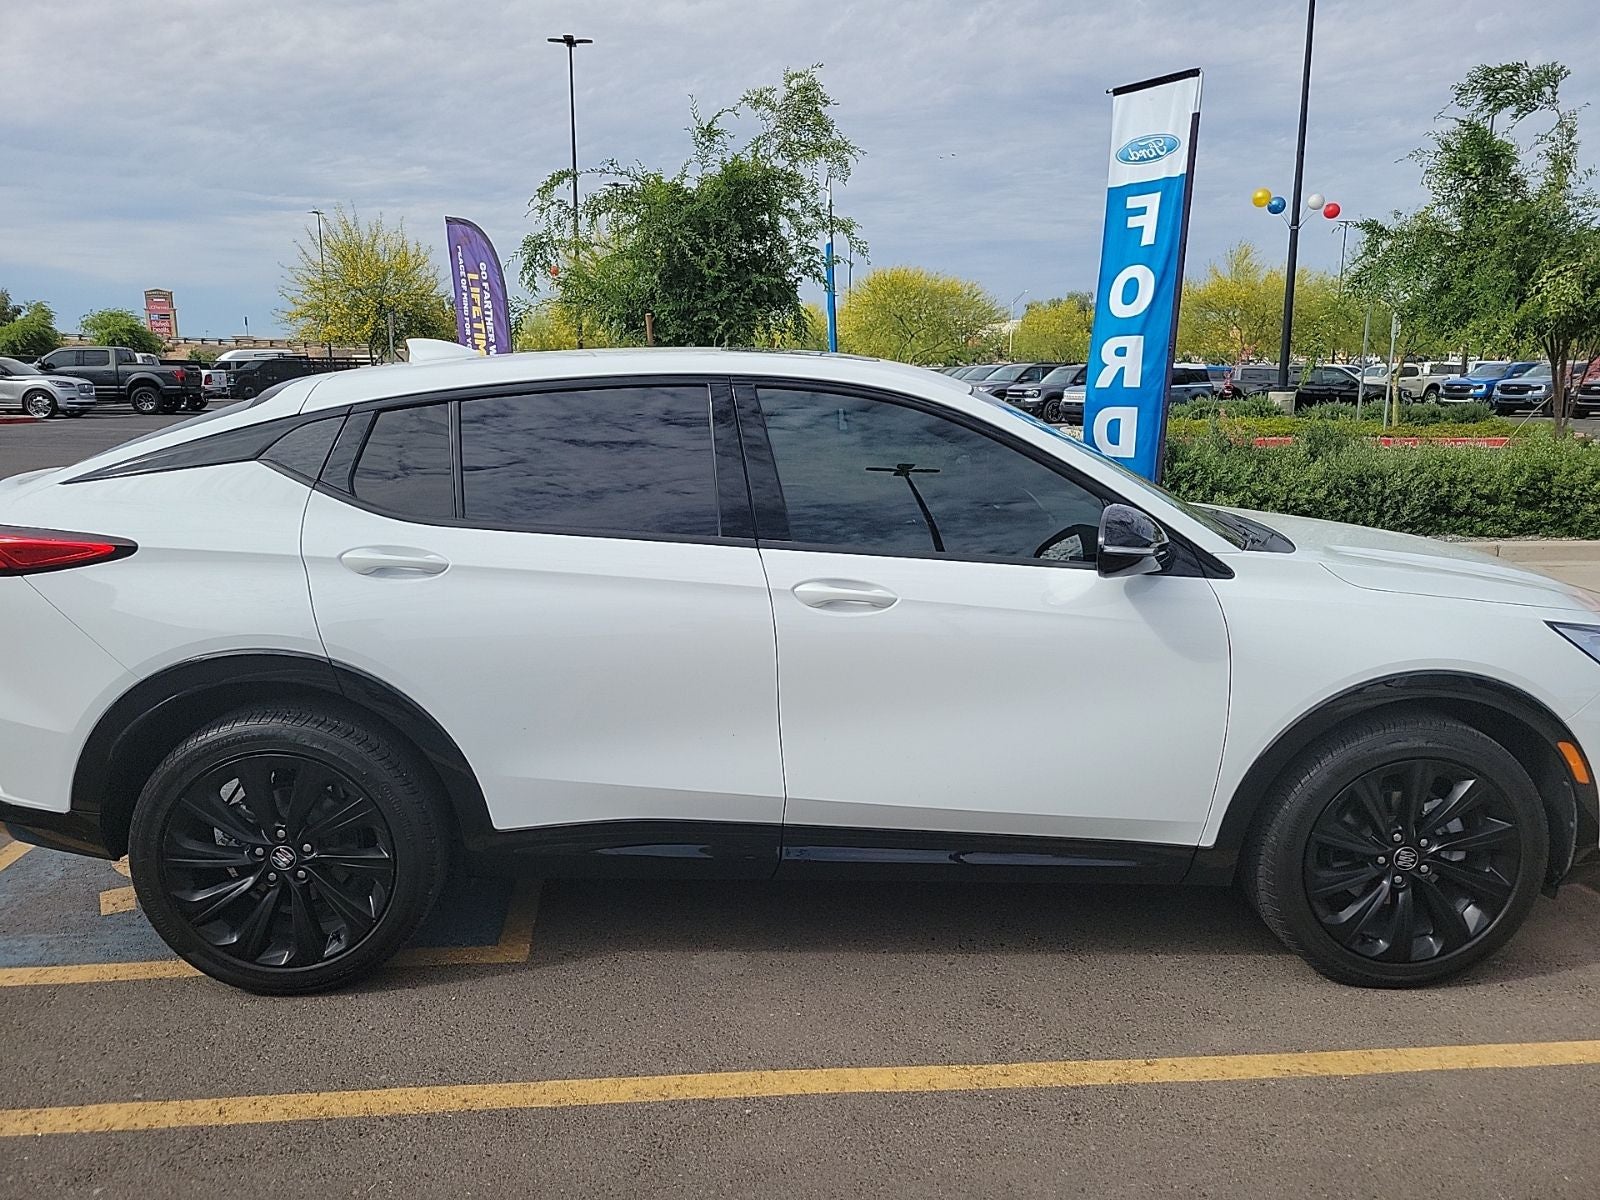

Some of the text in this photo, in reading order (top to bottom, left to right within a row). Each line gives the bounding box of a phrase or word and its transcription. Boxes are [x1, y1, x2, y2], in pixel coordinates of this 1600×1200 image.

[457, 245, 466, 278] PEACE
[480, 262, 488, 280] GO
[461, 279, 467, 292] OF
[482, 282, 495, 343] FARTHER
